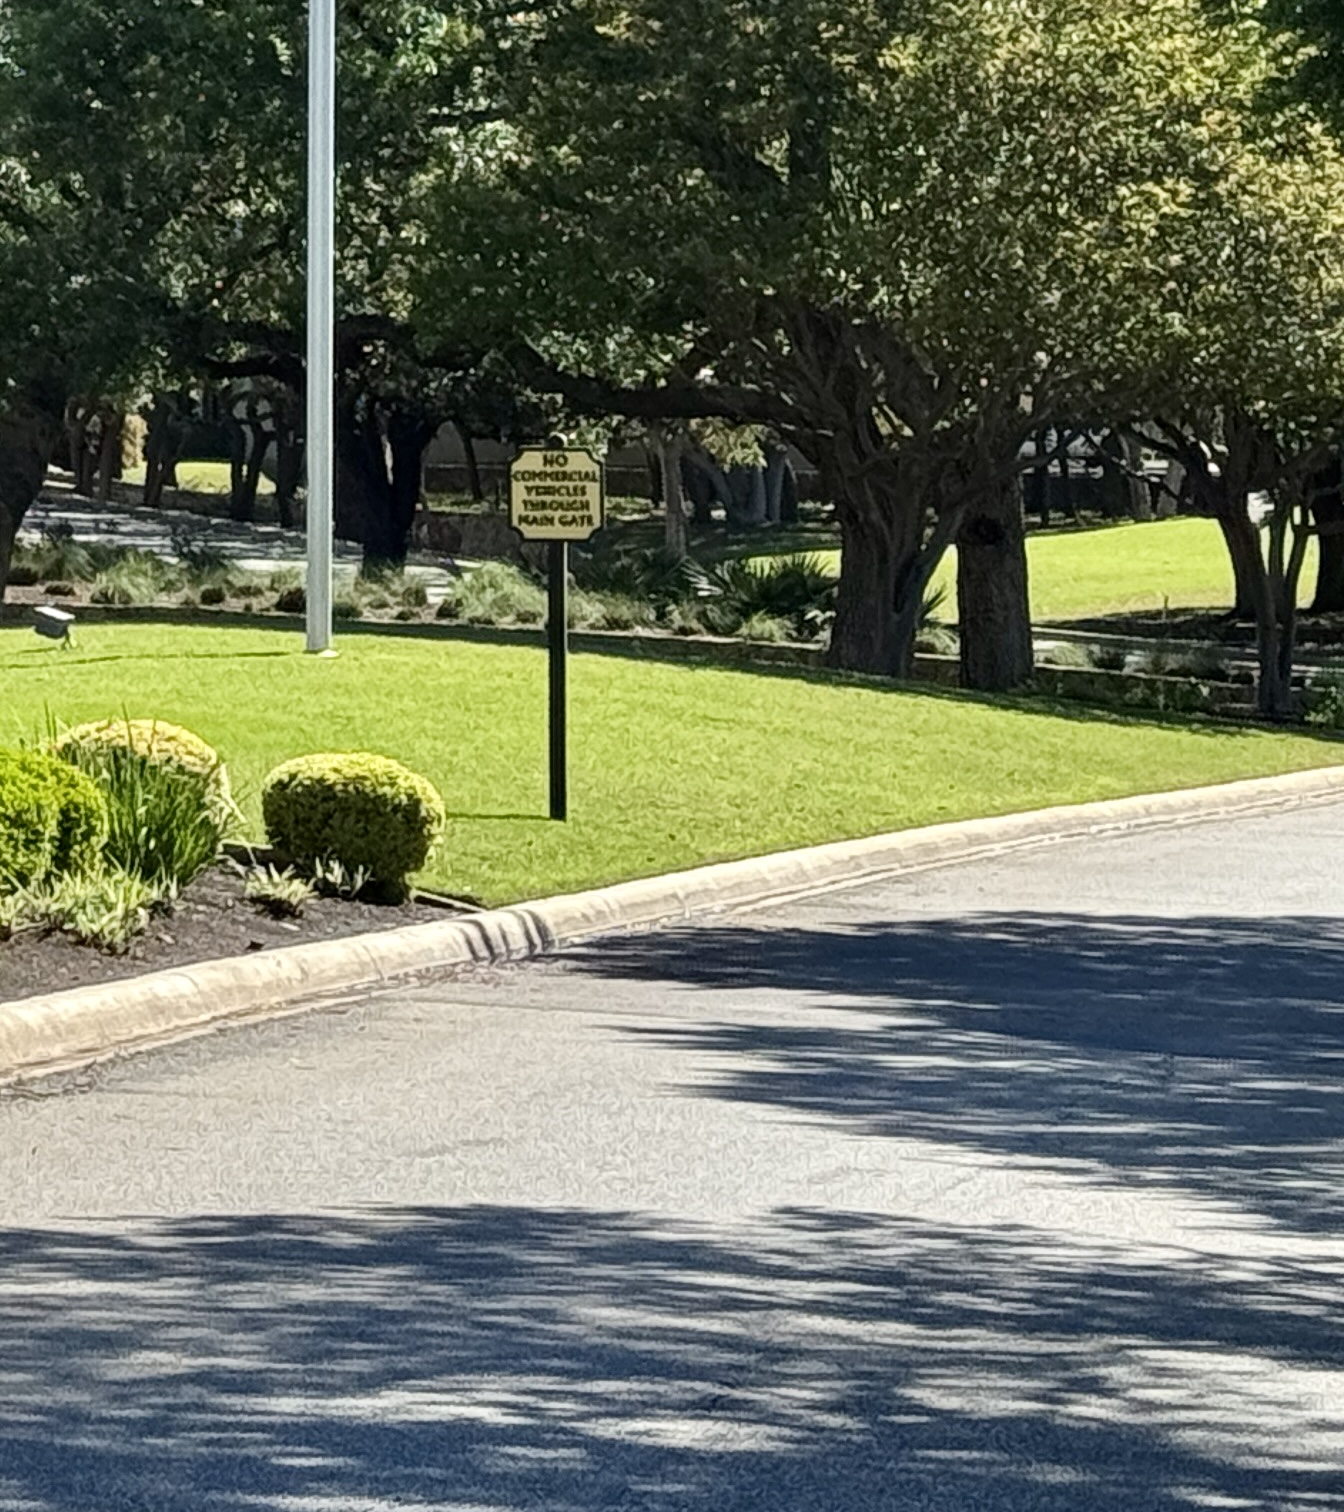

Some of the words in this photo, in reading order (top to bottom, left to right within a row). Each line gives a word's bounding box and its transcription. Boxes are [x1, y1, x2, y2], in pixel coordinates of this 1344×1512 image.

[543, 454, 568, 467] NO
[512, 470, 598, 483] COMMERCIAL
[524, 485, 587, 497] VEHICLES
[521, 499, 590, 512] THROUGH
[518, 514, 555, 527] MAIN
[558, 514, 594, 527] GATE
